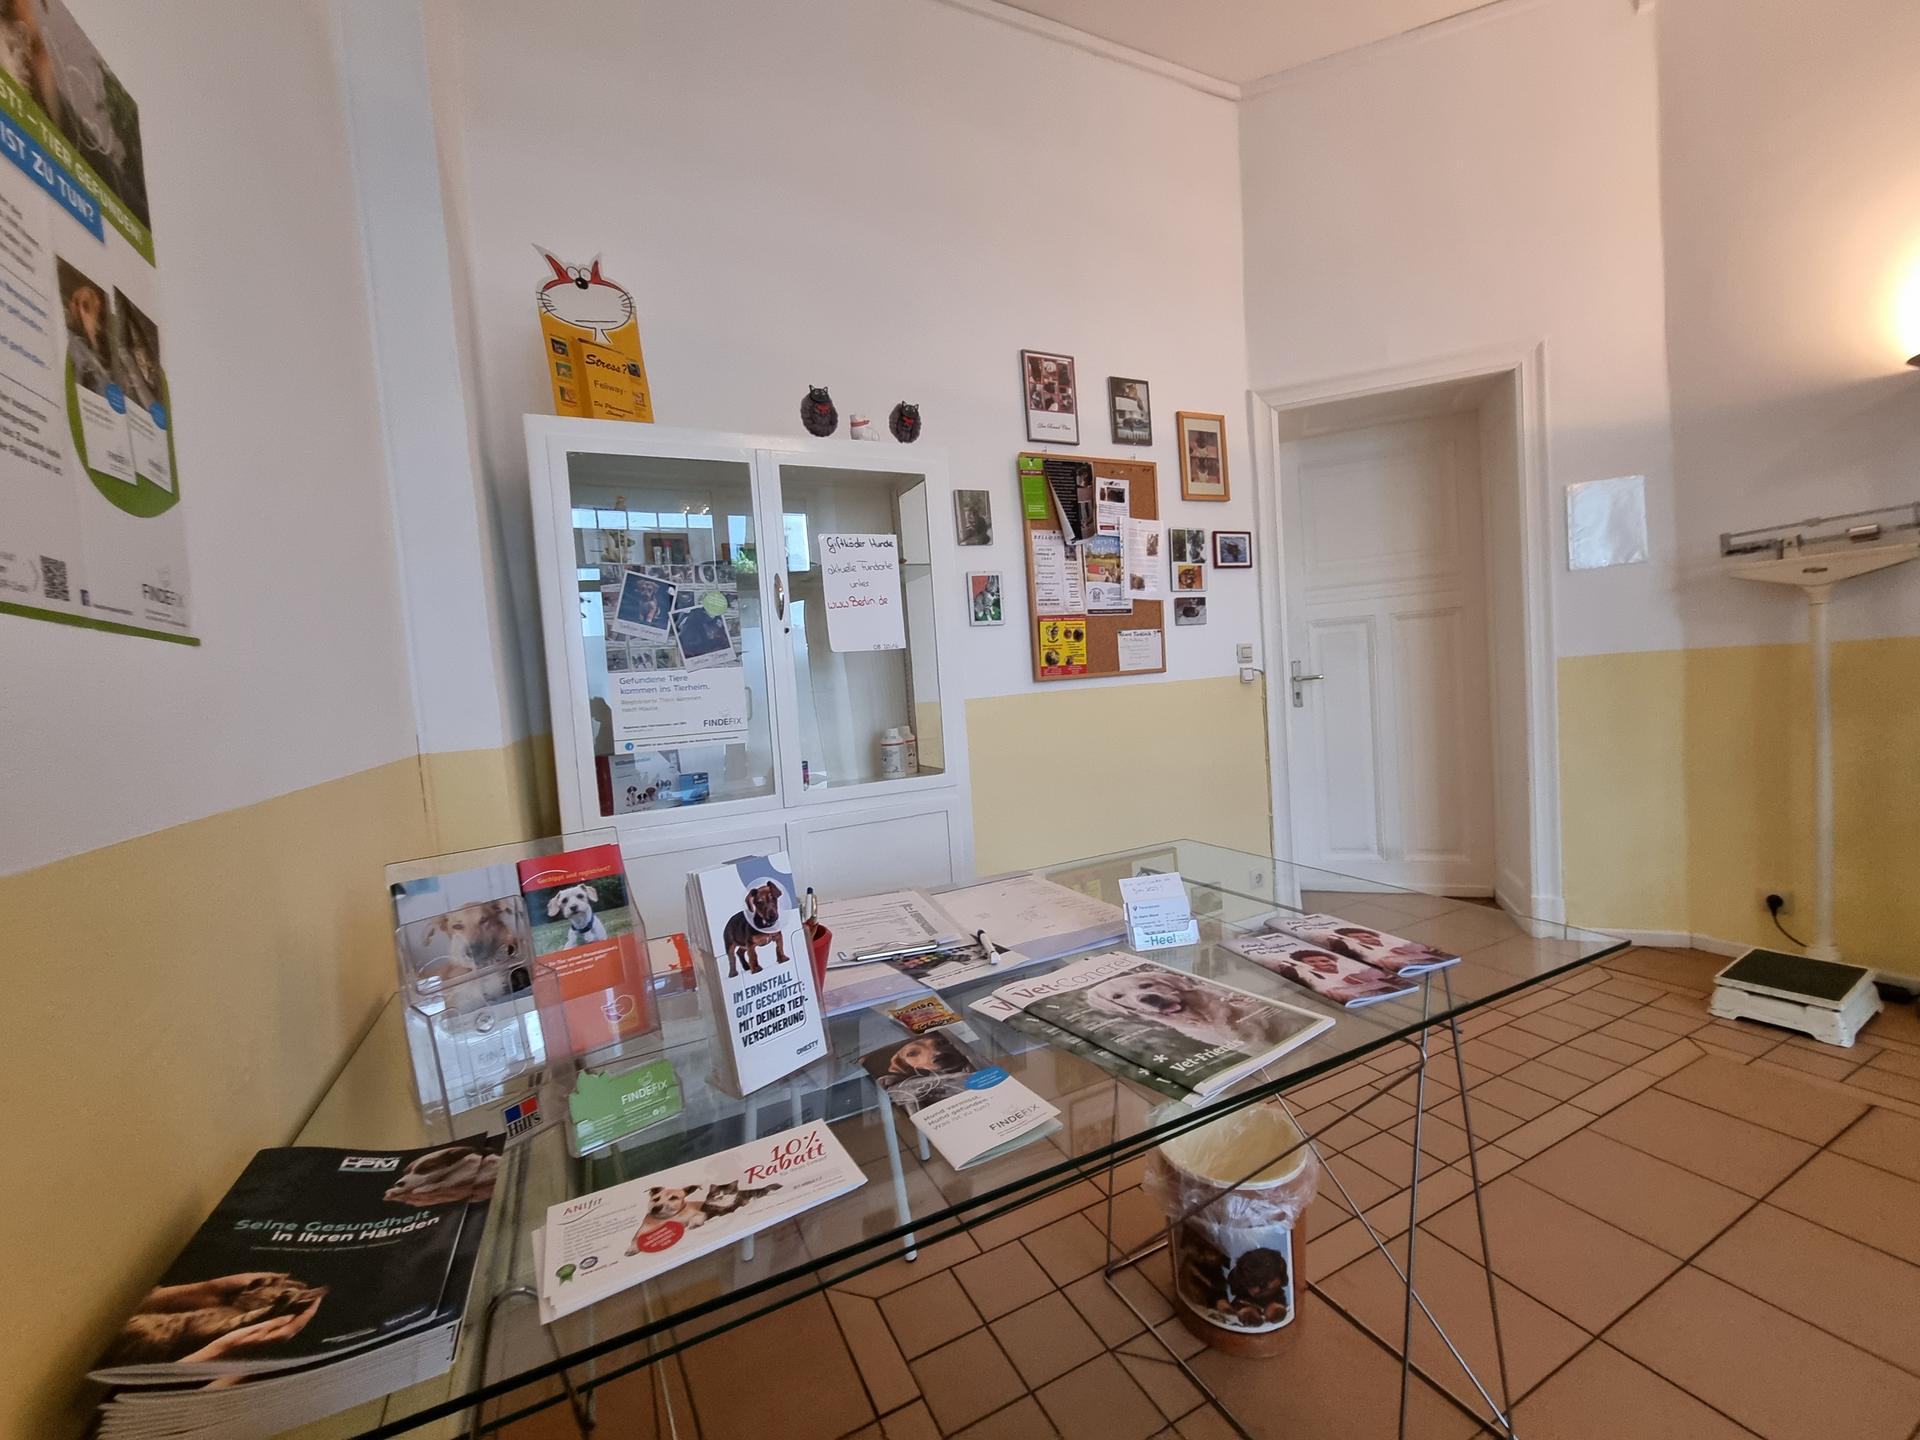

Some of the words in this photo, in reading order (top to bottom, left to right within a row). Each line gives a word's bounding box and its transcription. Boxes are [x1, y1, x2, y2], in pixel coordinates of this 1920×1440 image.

[31, 152, 54, 185] ZU
[585, 353, 628, 375] Stress?
[868, 537, 894, 548] Hunde
[619, 676, 666, 685] Gefundene
[669, 674, 688, 682] Tiere
[620, 686, 657, 695] kommen
[659, 684, 671, 693] ins
[703, 717, 742, 728] FINDEFIX
[733, 990, 745, 1004] IM
[745, 971, 793, 1000] ERNSTFALL
[735, 1000, 753, 1018] GUT
[738, 1017, 754, 1033] MIT
[755, 1005, 786, 1027] DEINER
[787, 995, 808, 1013] TIER-
[741, 1010, 805, 1048] VERSICHERUNG
[620, 1079, 668, 1105] FINDEFIX
[988, 1103, 1041, 1131] FINDEFIX
[770, 1130, 820, 1162] 10%
[744, 1142, 828, 1185] Rabatt
[233, 1219, 299, 1231] Seine
[304, 1210, 431, 1232] Gesundheit
[299, 1230, 353, 1243] Ihren
[358, 1216, 440, 1241] Händen
